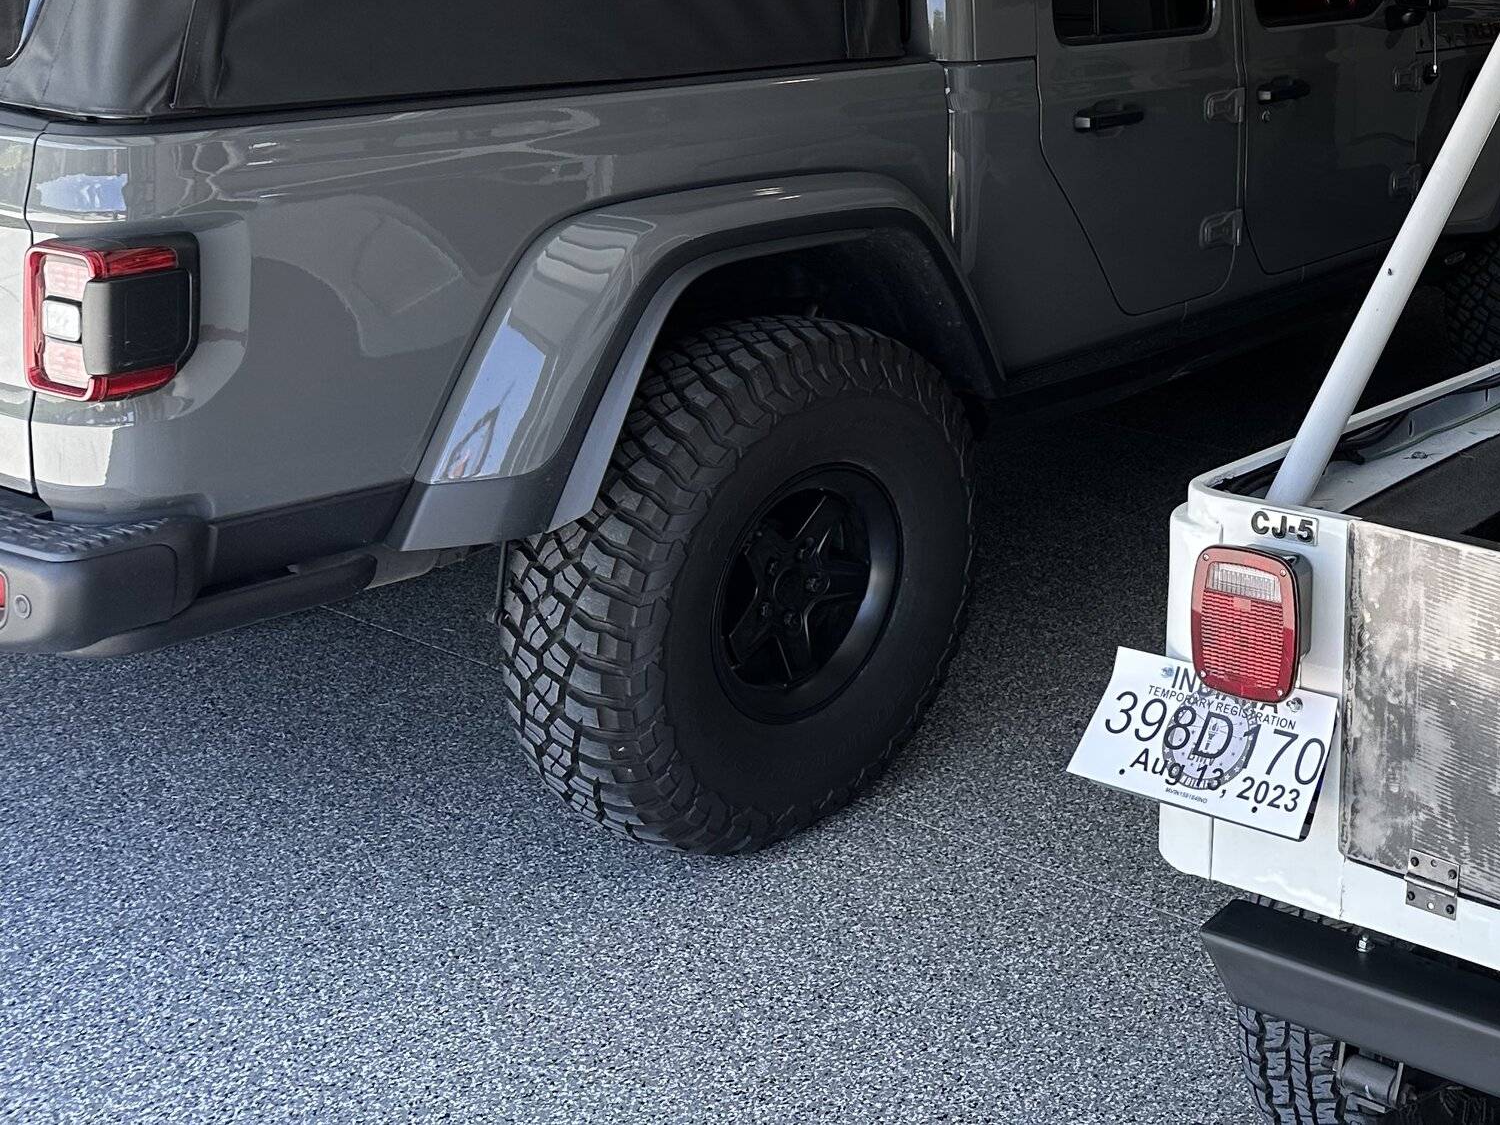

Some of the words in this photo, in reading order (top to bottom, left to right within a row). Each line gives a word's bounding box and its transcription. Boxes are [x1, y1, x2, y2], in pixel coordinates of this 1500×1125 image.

[1251, 510, 1314, 542] CJ-5
[1148, 684, 1214, 709] TEMPORARY
[1215, 700, 1297, 730] REGISTRATION
[1104, 691, 1326, 785] 398D170
[1130, 748, 1186, 786] Aug
[1196, 765, 1227, 799] 13,
[1237, 776, 1301, 813] 2023
